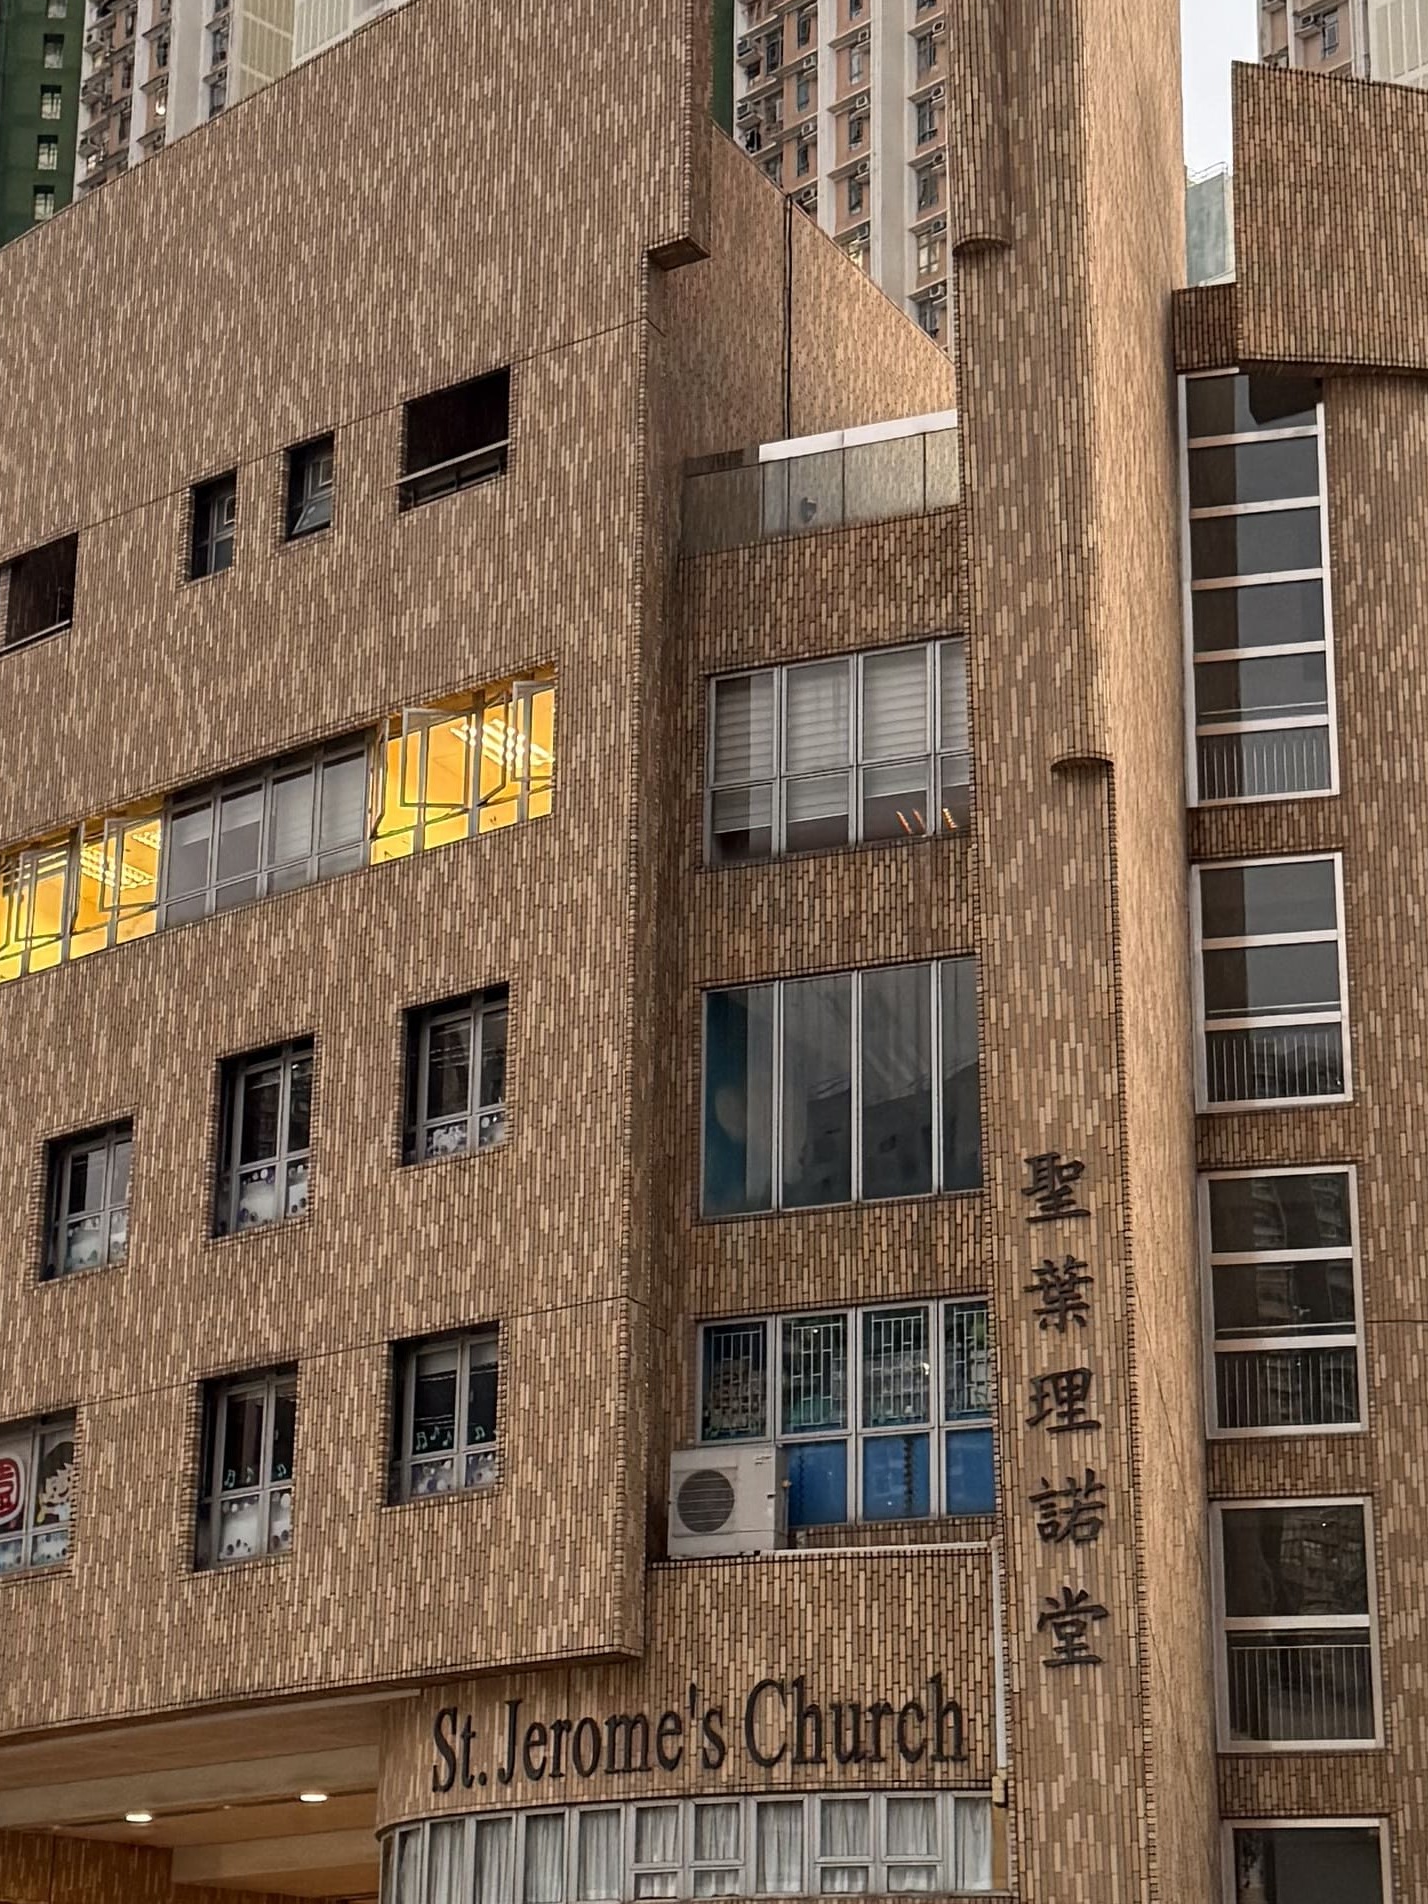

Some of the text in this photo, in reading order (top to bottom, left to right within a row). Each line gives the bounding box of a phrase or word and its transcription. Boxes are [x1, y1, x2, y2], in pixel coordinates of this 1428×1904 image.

[1022, 1151, 1109, 1668] 聖葉理諾堂
[431, 1673, 968, 1793] St. Jerome's Church
